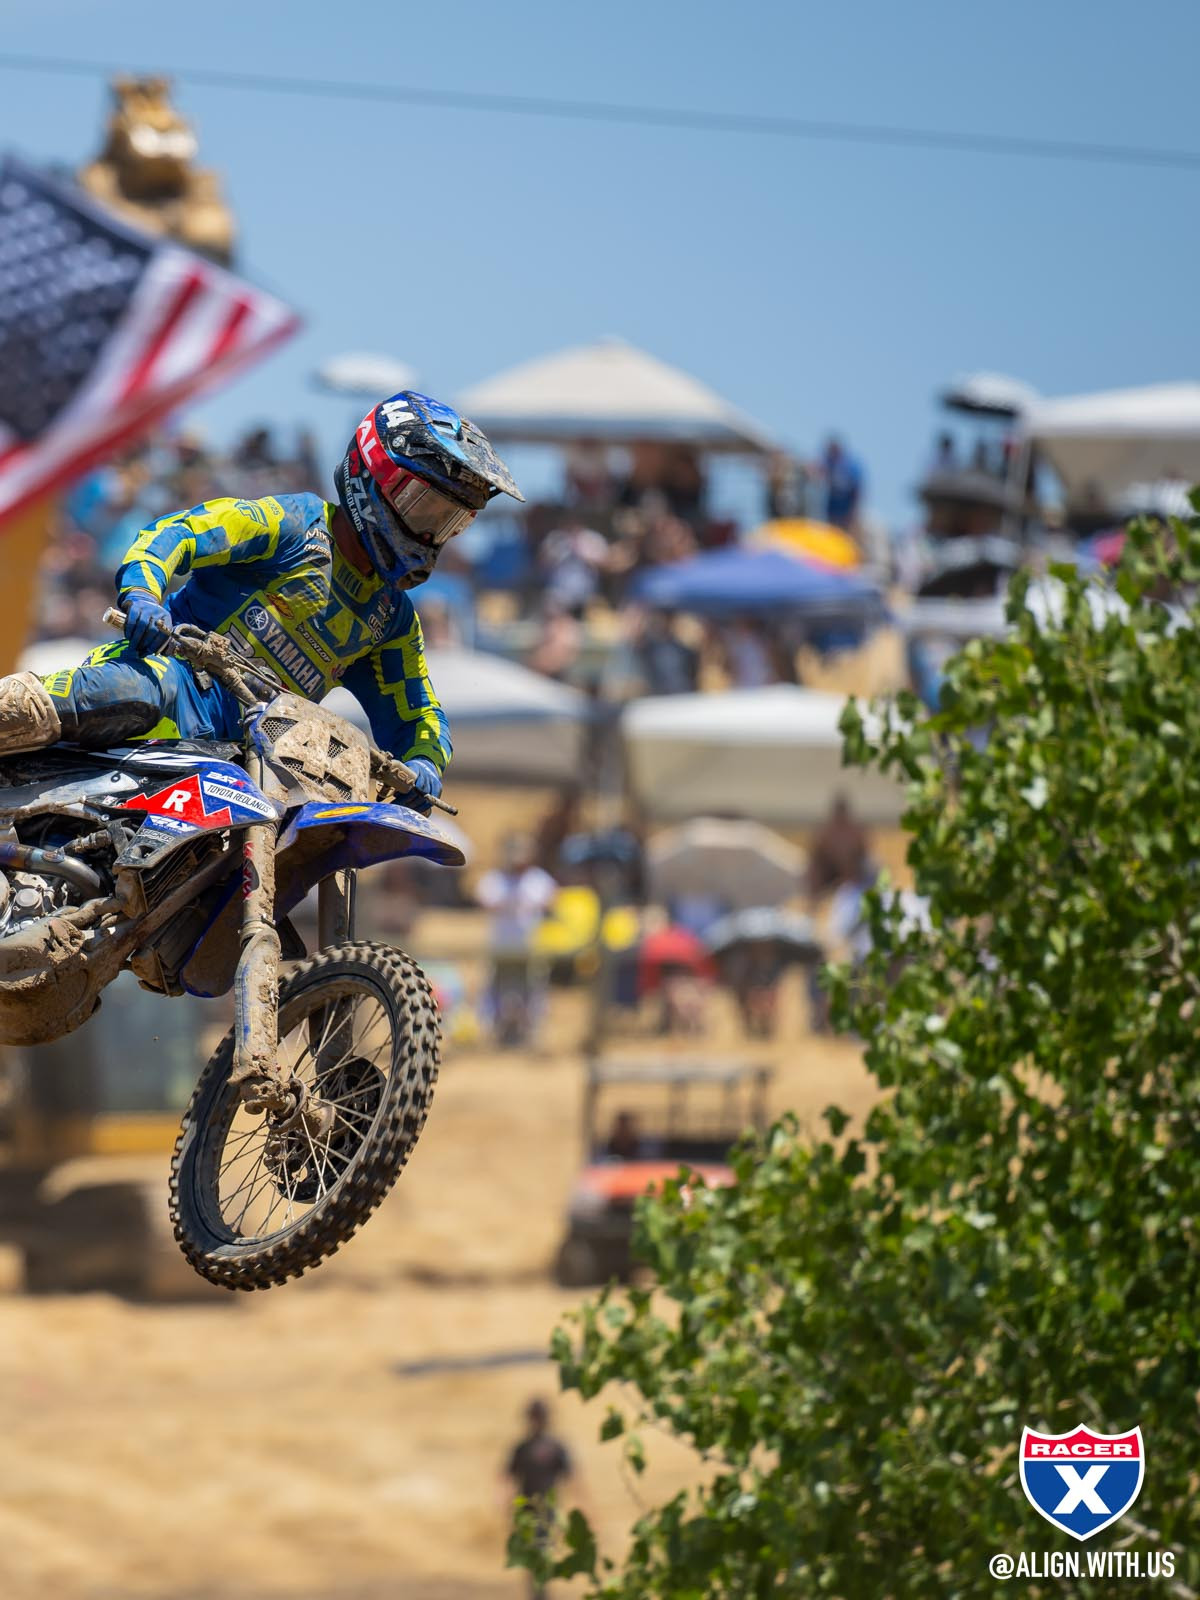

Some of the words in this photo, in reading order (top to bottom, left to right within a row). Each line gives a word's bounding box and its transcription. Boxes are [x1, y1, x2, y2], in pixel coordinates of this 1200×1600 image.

[381, 400, 415, 428] 44
[350, 477, 377, 524] FLY
[261, 622, 323, 694] YAMAHA
[302, 631, 332, 663] DUNLOP
[162, 790, 192, 813] R
[207, 784, 233, 798] TOYOTA
[234, 792, 271, 814] REDLANDS
